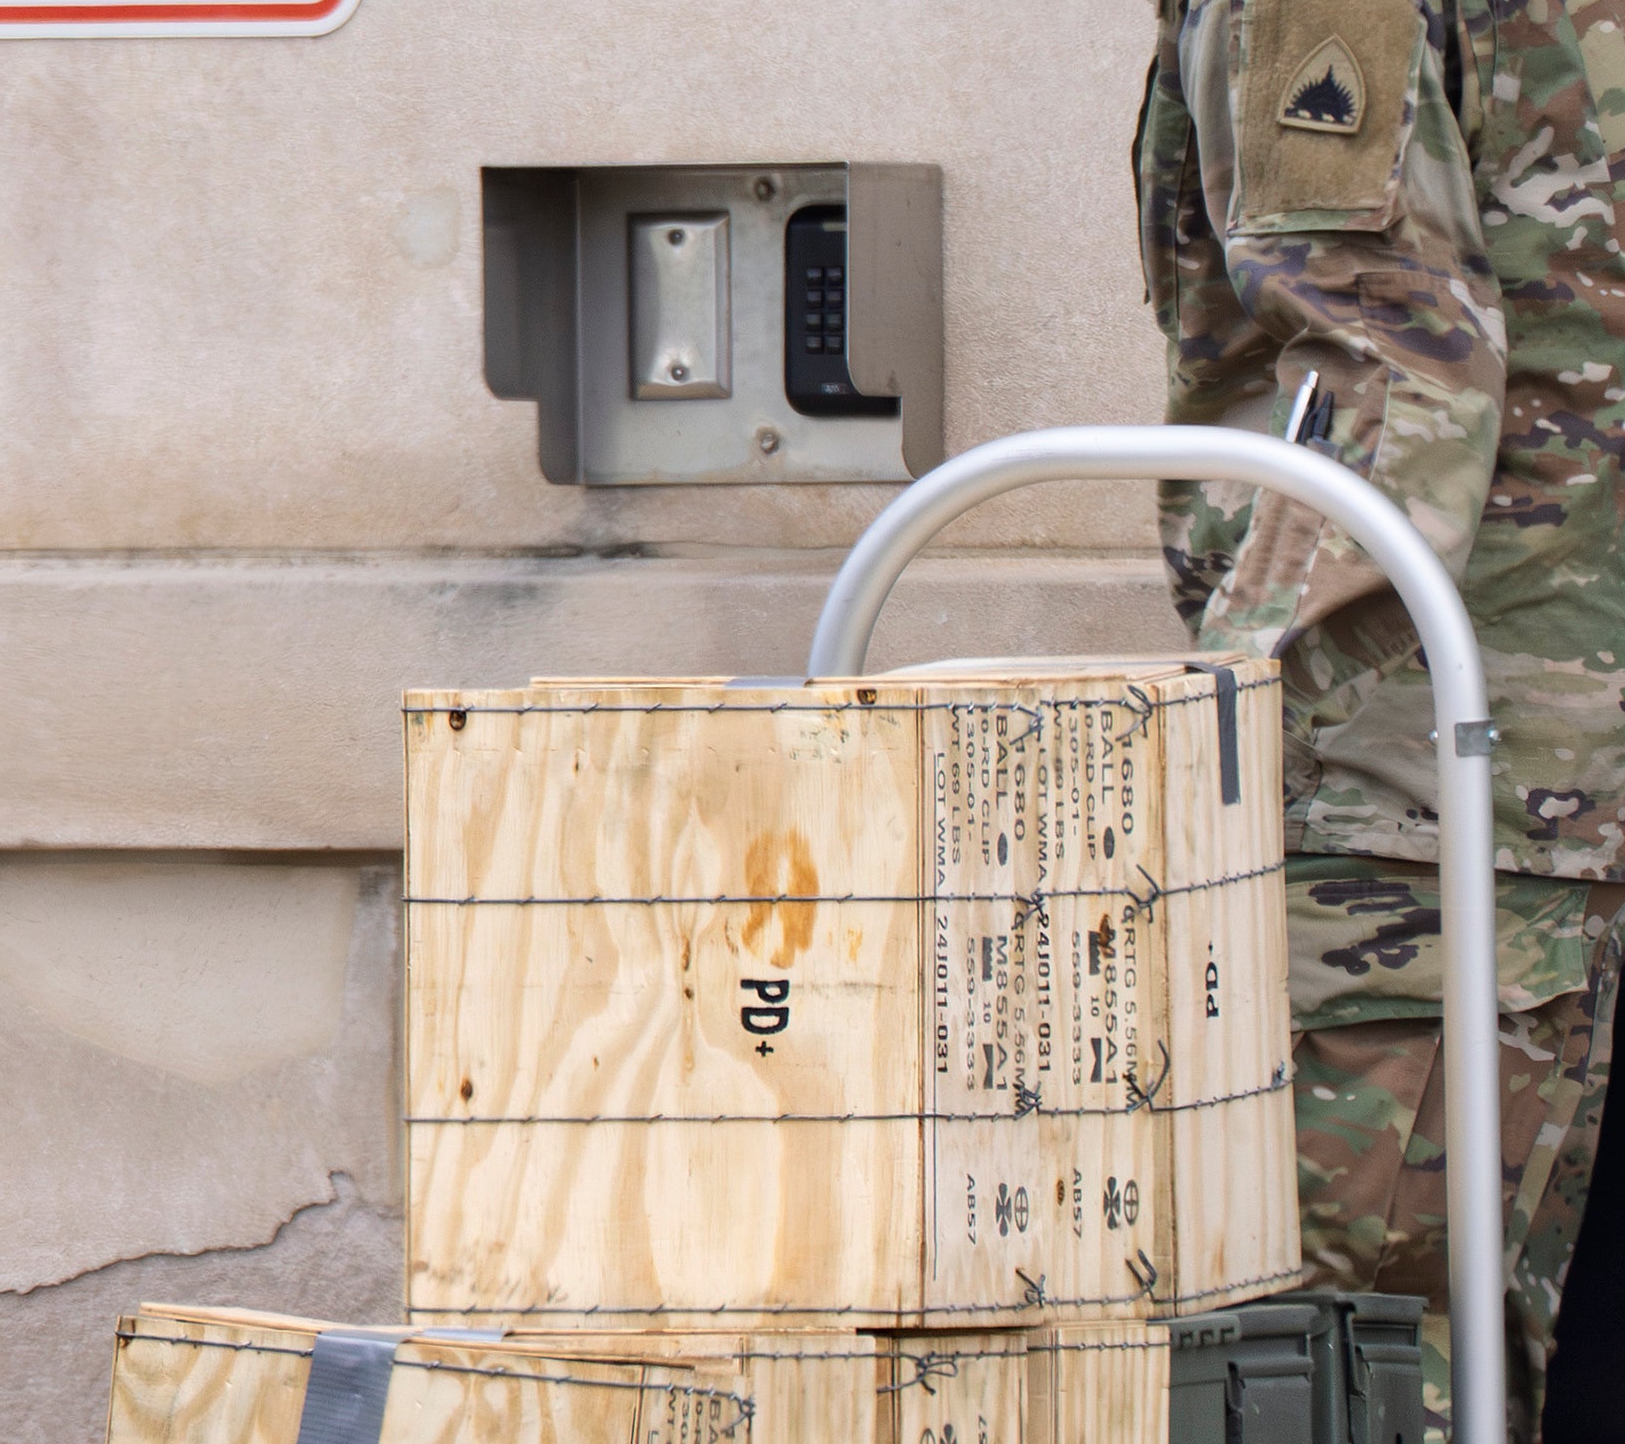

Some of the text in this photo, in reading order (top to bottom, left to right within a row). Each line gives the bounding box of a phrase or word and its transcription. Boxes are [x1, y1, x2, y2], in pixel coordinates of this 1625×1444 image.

[951, 806, 962, 865] LBS
[981, 799, 991, 866] CLIP
[1037, 813, 1048, 883] WMA
[1055, 801, 1065, 860] LBS
[1085, 794, 1096, 861] CLIP
[936, 752, 949, 1073] LOT WMA 24J011-031
[995, 715, 1009, 1090] BALL M855A1
[1100, 710, 1119, 1085] BALL M855A1
[966, 937, 976, 1092] 559-3333
[1071, 931, 1082, 1086] 559-3333
[966, 1173, 977, 1245] AB57
[1072, 1168, 1083, 1239] AB57
